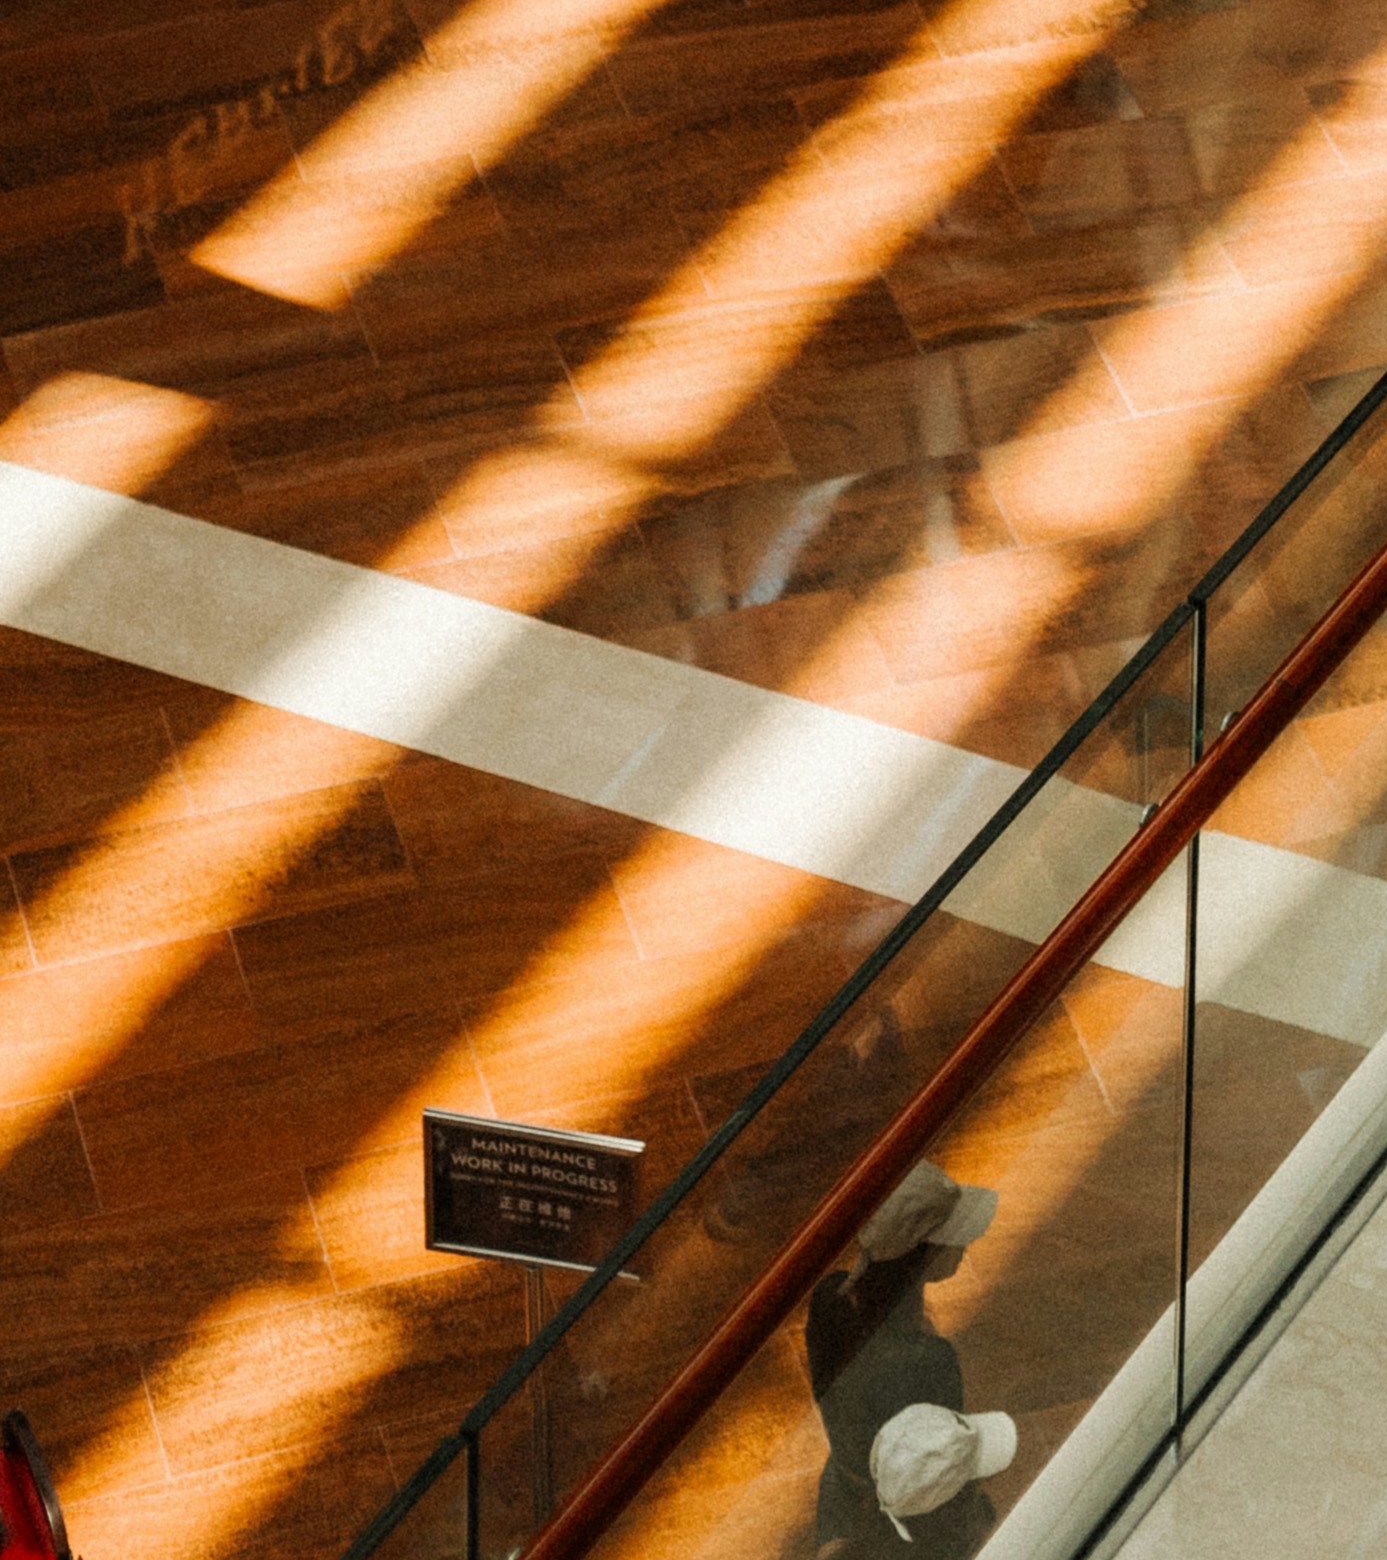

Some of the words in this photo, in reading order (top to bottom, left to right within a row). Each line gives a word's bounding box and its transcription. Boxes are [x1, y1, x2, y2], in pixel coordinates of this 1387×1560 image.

[451, 1152, 502, 1172] WORK
[508, 1163, 526, 1174] IN
[531, 1166, 618, 1194] PROGRESS
[471, 1137, 596, 1171] MAINTENANCE
